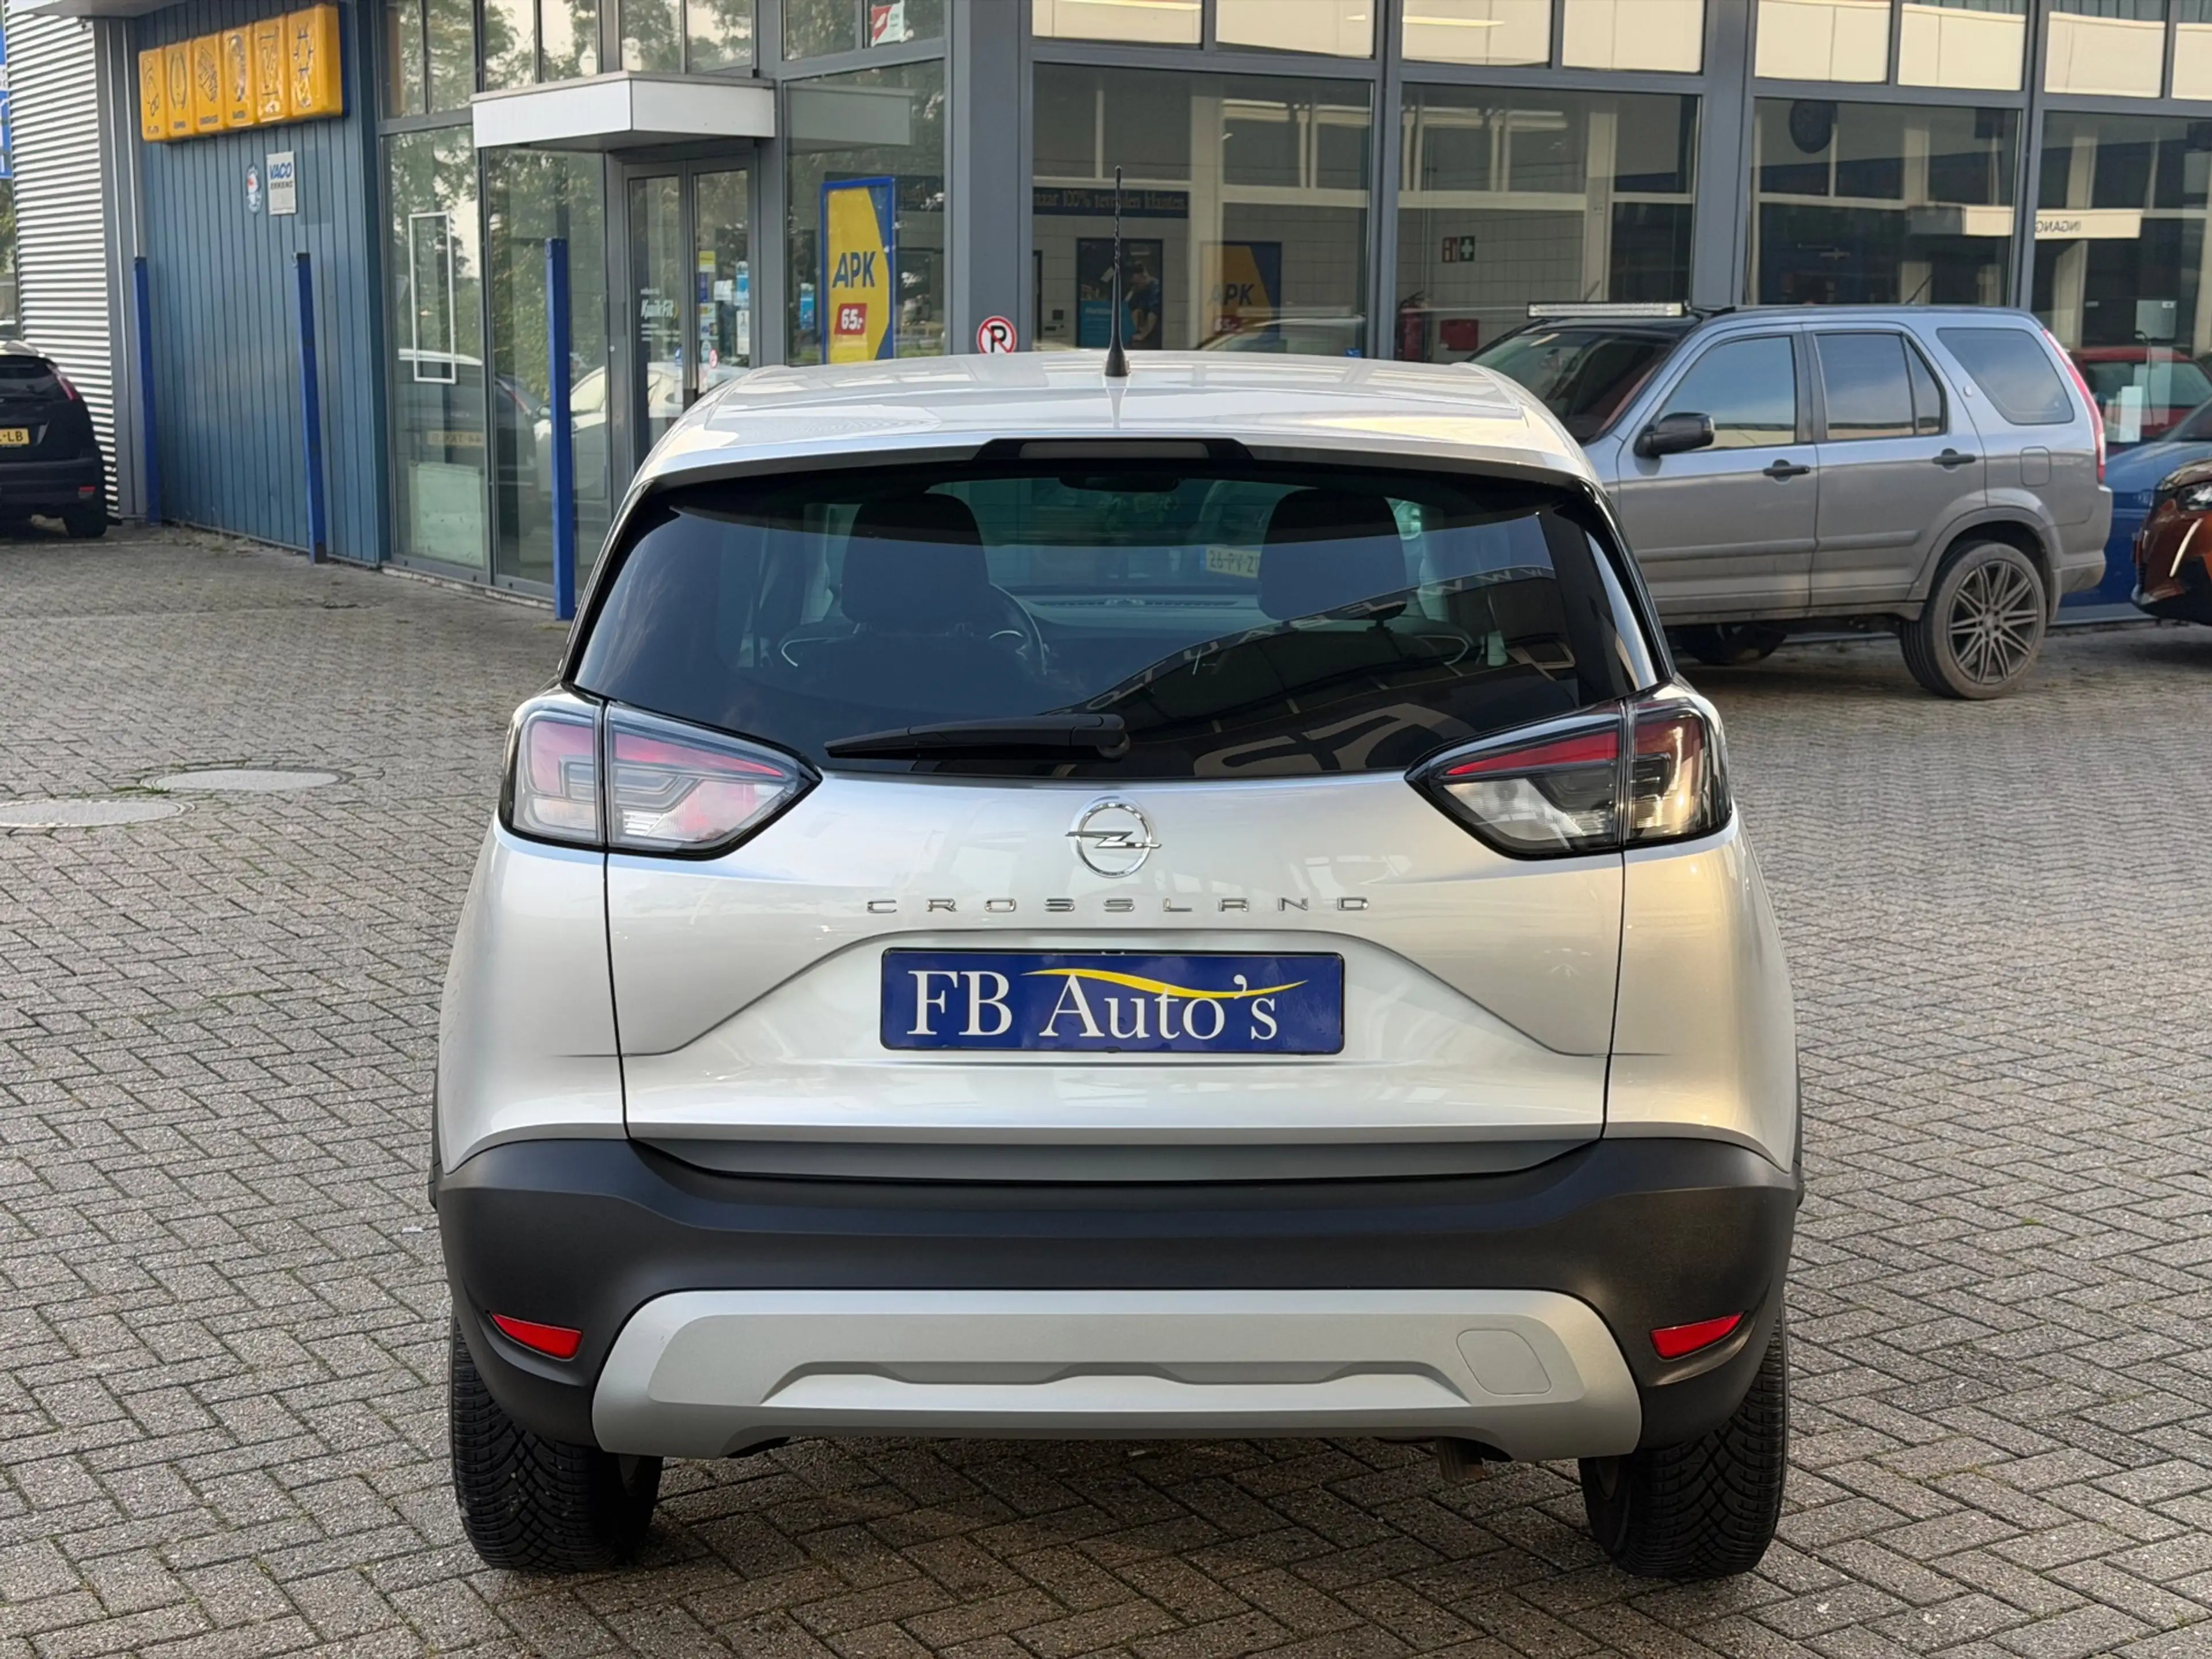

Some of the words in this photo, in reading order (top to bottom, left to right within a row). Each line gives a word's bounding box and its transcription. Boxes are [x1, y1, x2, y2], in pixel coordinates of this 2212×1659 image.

[270, 162, 291, 179] VACO
[1095, 191, 1141, 209] tevrden
[832, 251, 876, 288] APK
[1207, 283, 1256, 306] APK
[0, 430, 24, 442] -LB
[866, 896, 1370, 913] CROSSLAND
[907, 970, 1013, 1036] FB
[1039, 974, 1278, 1040] Auto's
